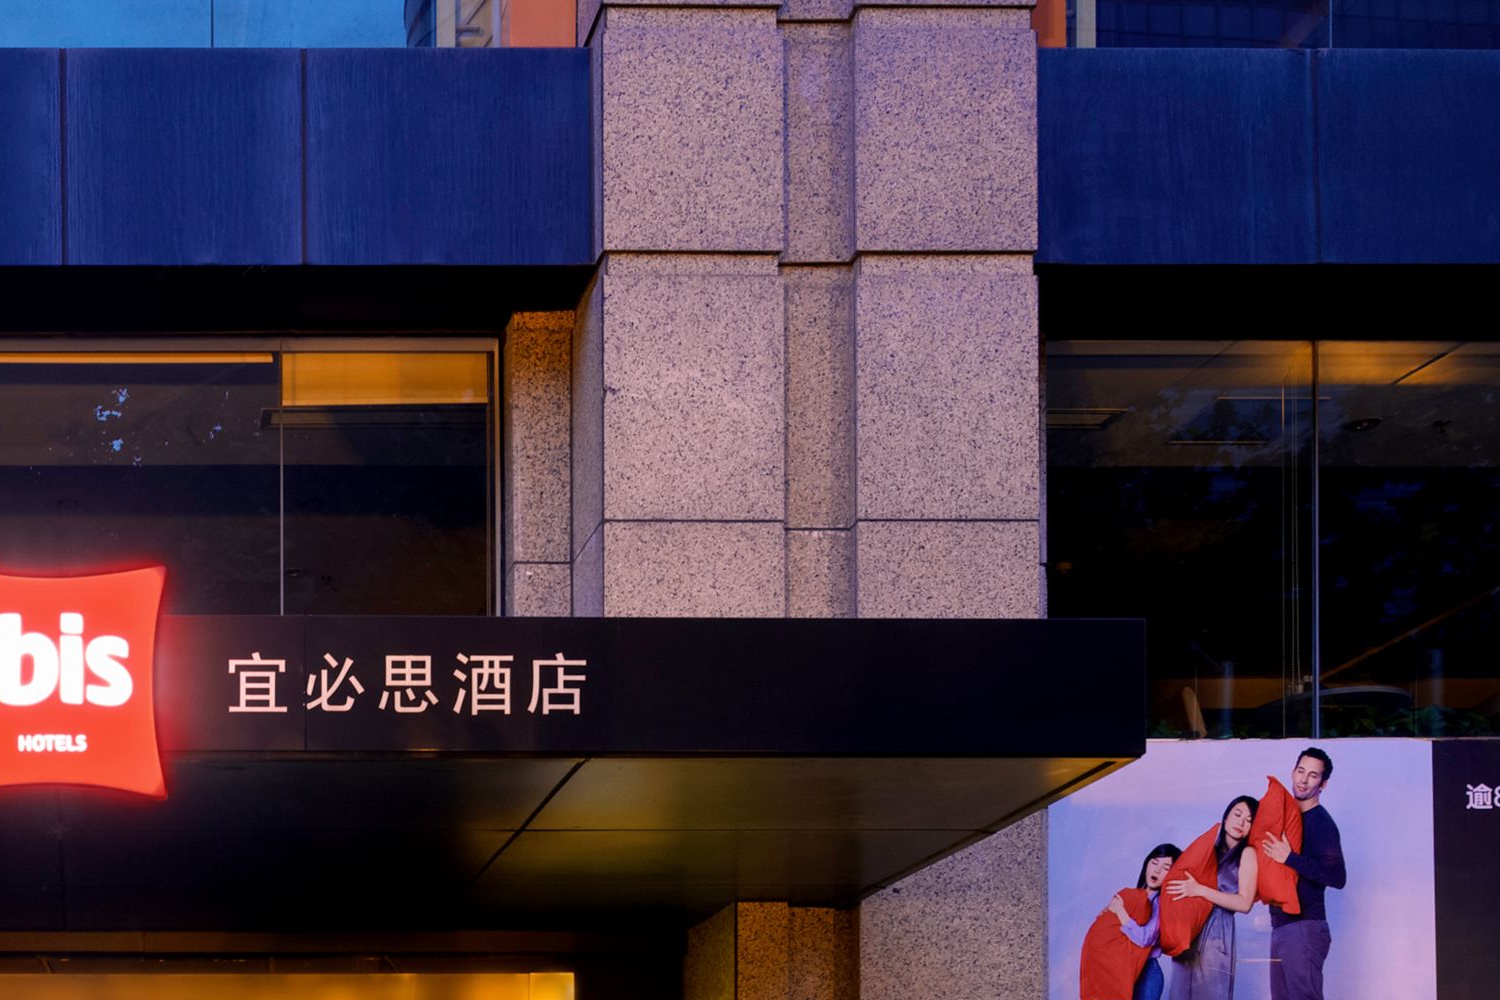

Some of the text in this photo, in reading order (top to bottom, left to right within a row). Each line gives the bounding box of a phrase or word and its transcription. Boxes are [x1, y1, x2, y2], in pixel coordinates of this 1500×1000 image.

[228, 651, 587, 716] 宜必思酒店
[17, 734, 88, 752] HOTELS
